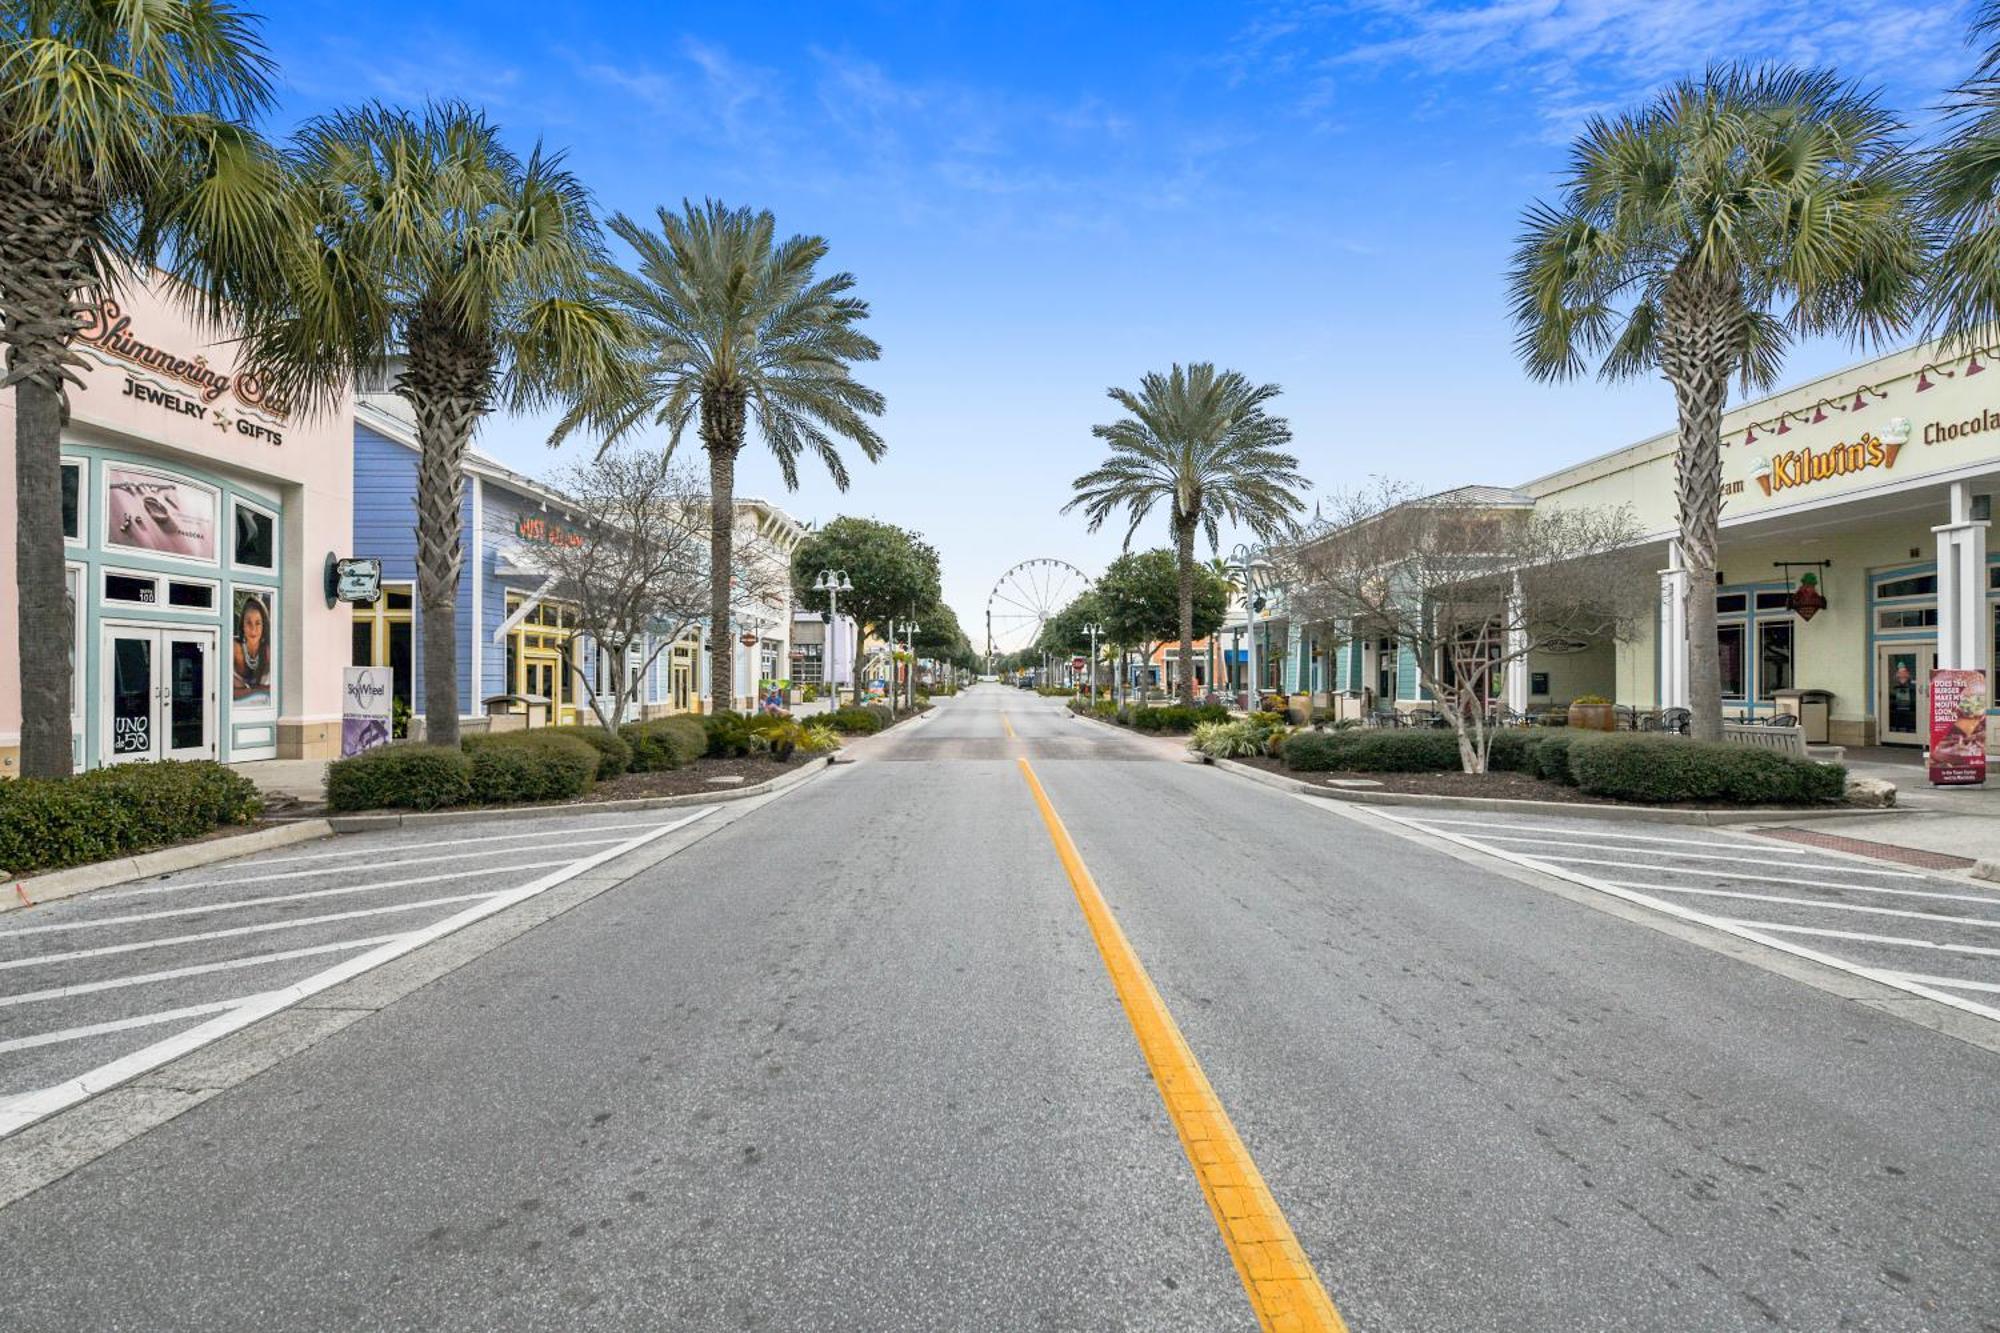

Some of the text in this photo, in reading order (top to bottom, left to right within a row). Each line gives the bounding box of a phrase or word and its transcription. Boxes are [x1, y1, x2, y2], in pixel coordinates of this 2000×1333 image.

[122, 378, 283, 446] JEWELRY GIFTS
[1772, 432, 1885, 491] Kilwin's
[139, 593, 154, 602] 100
[347, 683, 385, 699] SkyWheel
[116, 716, 148, 733] UNO
[125, 732, 149, 750] 50
